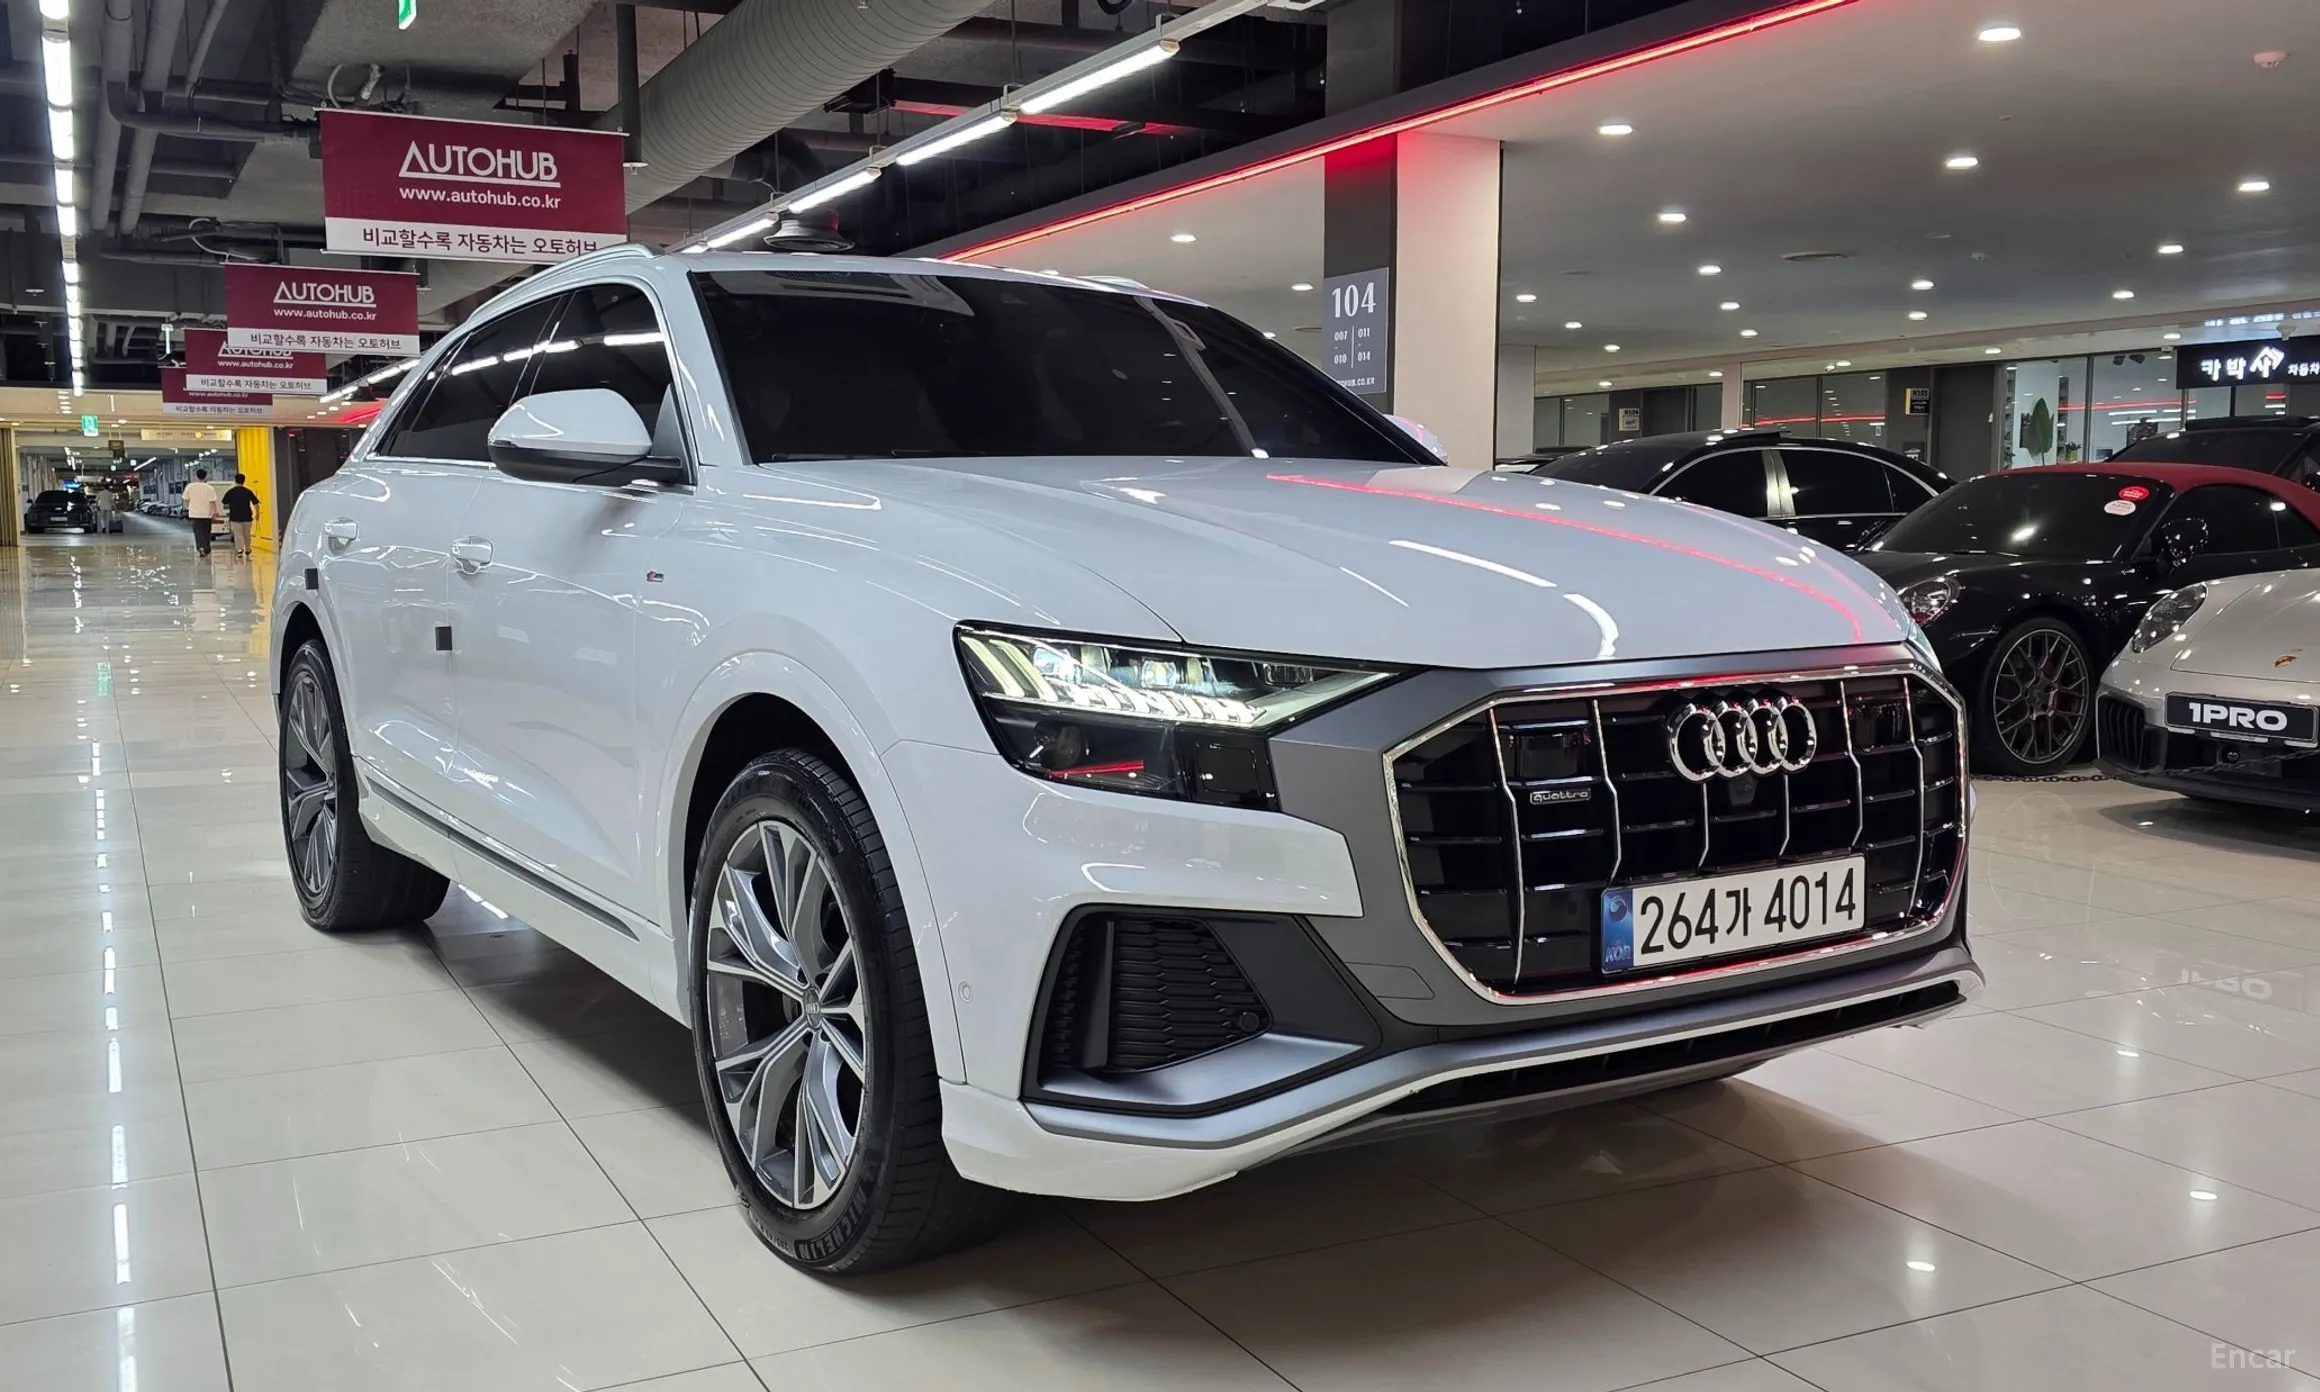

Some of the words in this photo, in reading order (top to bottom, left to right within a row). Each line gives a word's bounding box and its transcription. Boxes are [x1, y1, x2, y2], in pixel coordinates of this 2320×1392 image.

[399, 140, 561, 188] AUTOHUB
[399, 187, 561, 209] www.autohub.co.kr
[362, 228, 452, 251] 비교할수록
[458, 233, 527, 255] 자동차는
[273, 281, 377, 308] AUTOHUB
[1332, 282, 1376, 318] 104
[273, 308, 377, 321] www.autohub.co.kr
[250, 333, 307, 347] 비교할수록
[310, 336, 355, 349] 자동차는
[358, 338, 401, 350] 오토허브
[1334, 331, 1348, 341] 007
[1357, 328, 1371, 338] 011
[218, 361, 294, 370] www.autohub.co.kr
[1333, 354, 1348, 364] 010
[1357, 351, 1371, 362] 014
[2189, 702, 2288, 731] 1PRO
[1533, 790, 1588, 802] quattro
[1641, 887, 1752, 955] 264가
[1764, 868, 1856, 933] 4014
[798, 1184, 868, 1260] MICHELIN
